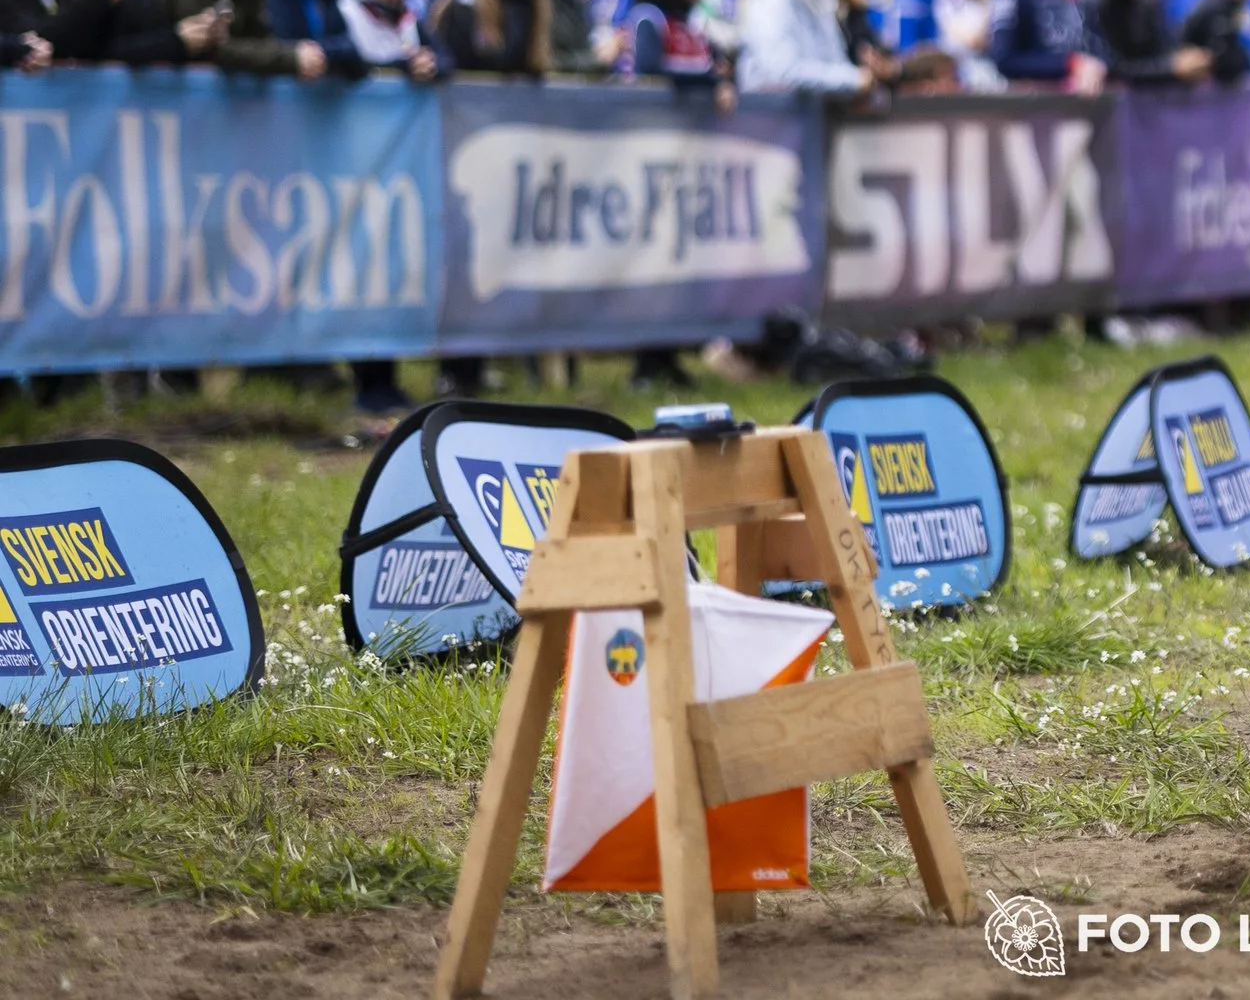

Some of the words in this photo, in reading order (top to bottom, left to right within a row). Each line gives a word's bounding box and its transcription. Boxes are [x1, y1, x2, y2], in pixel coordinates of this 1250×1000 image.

[0, 110, 426, 322] Folksam
[870, 440, 935, 494] SVENSK
[0, 519, 126, 587] SVENSK
[885, 503, 989, 565] ORIENTERING
[41, 588, 223, 669] ORIENTERING
